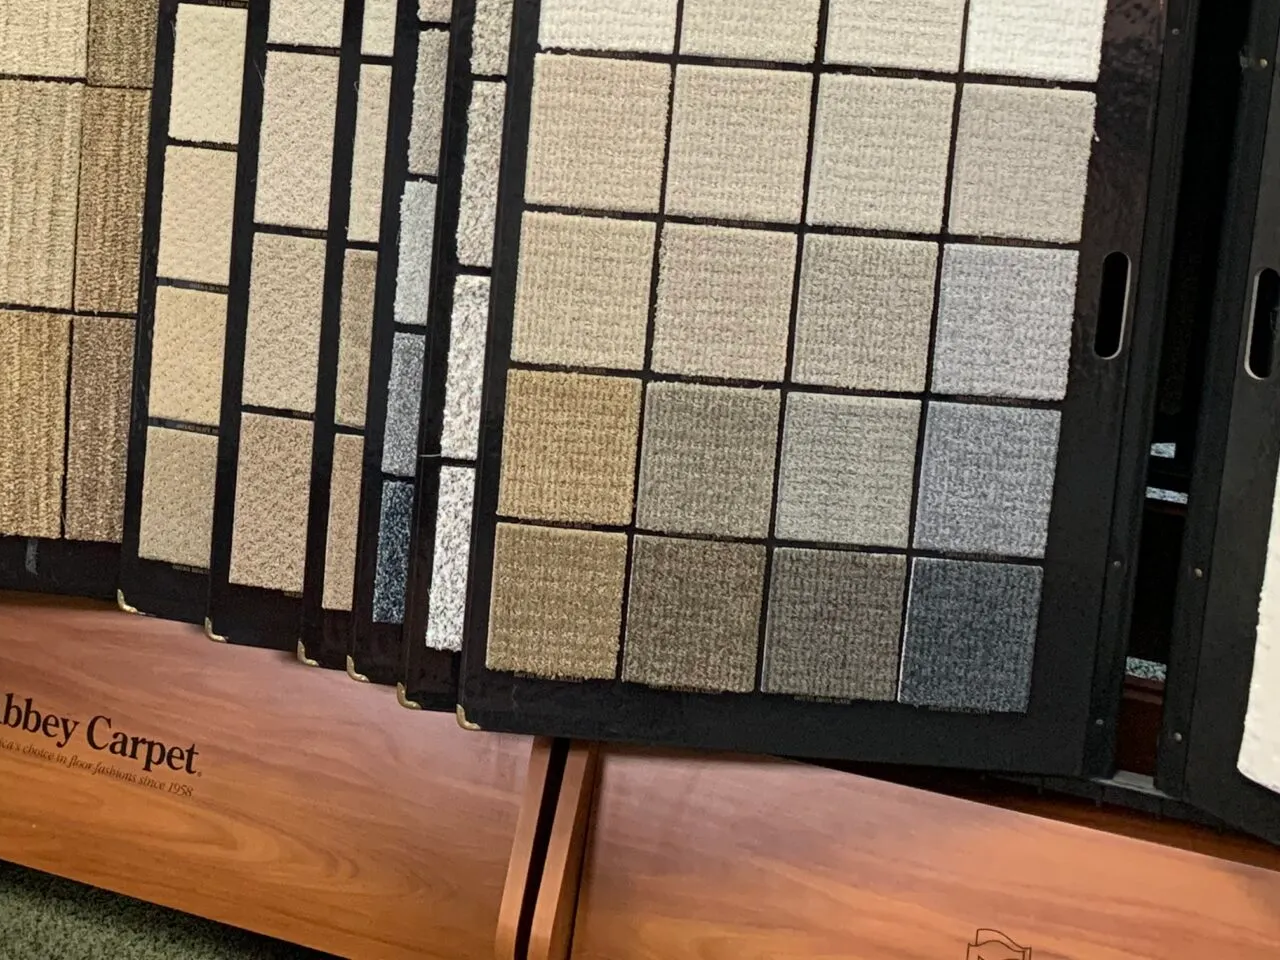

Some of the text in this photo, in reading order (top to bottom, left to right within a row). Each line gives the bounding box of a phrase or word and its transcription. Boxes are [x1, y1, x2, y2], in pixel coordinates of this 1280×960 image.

[22, 742, 55, 764] choice
[56, 753, 67, 766] in
[67, 754, 92, 772] floor
[92, 762, 137, 786] fashions
[137, 775, 165, 792] since
[167, 781, 194, 798] 1958
[86, 715, 200, 776] Carpet
